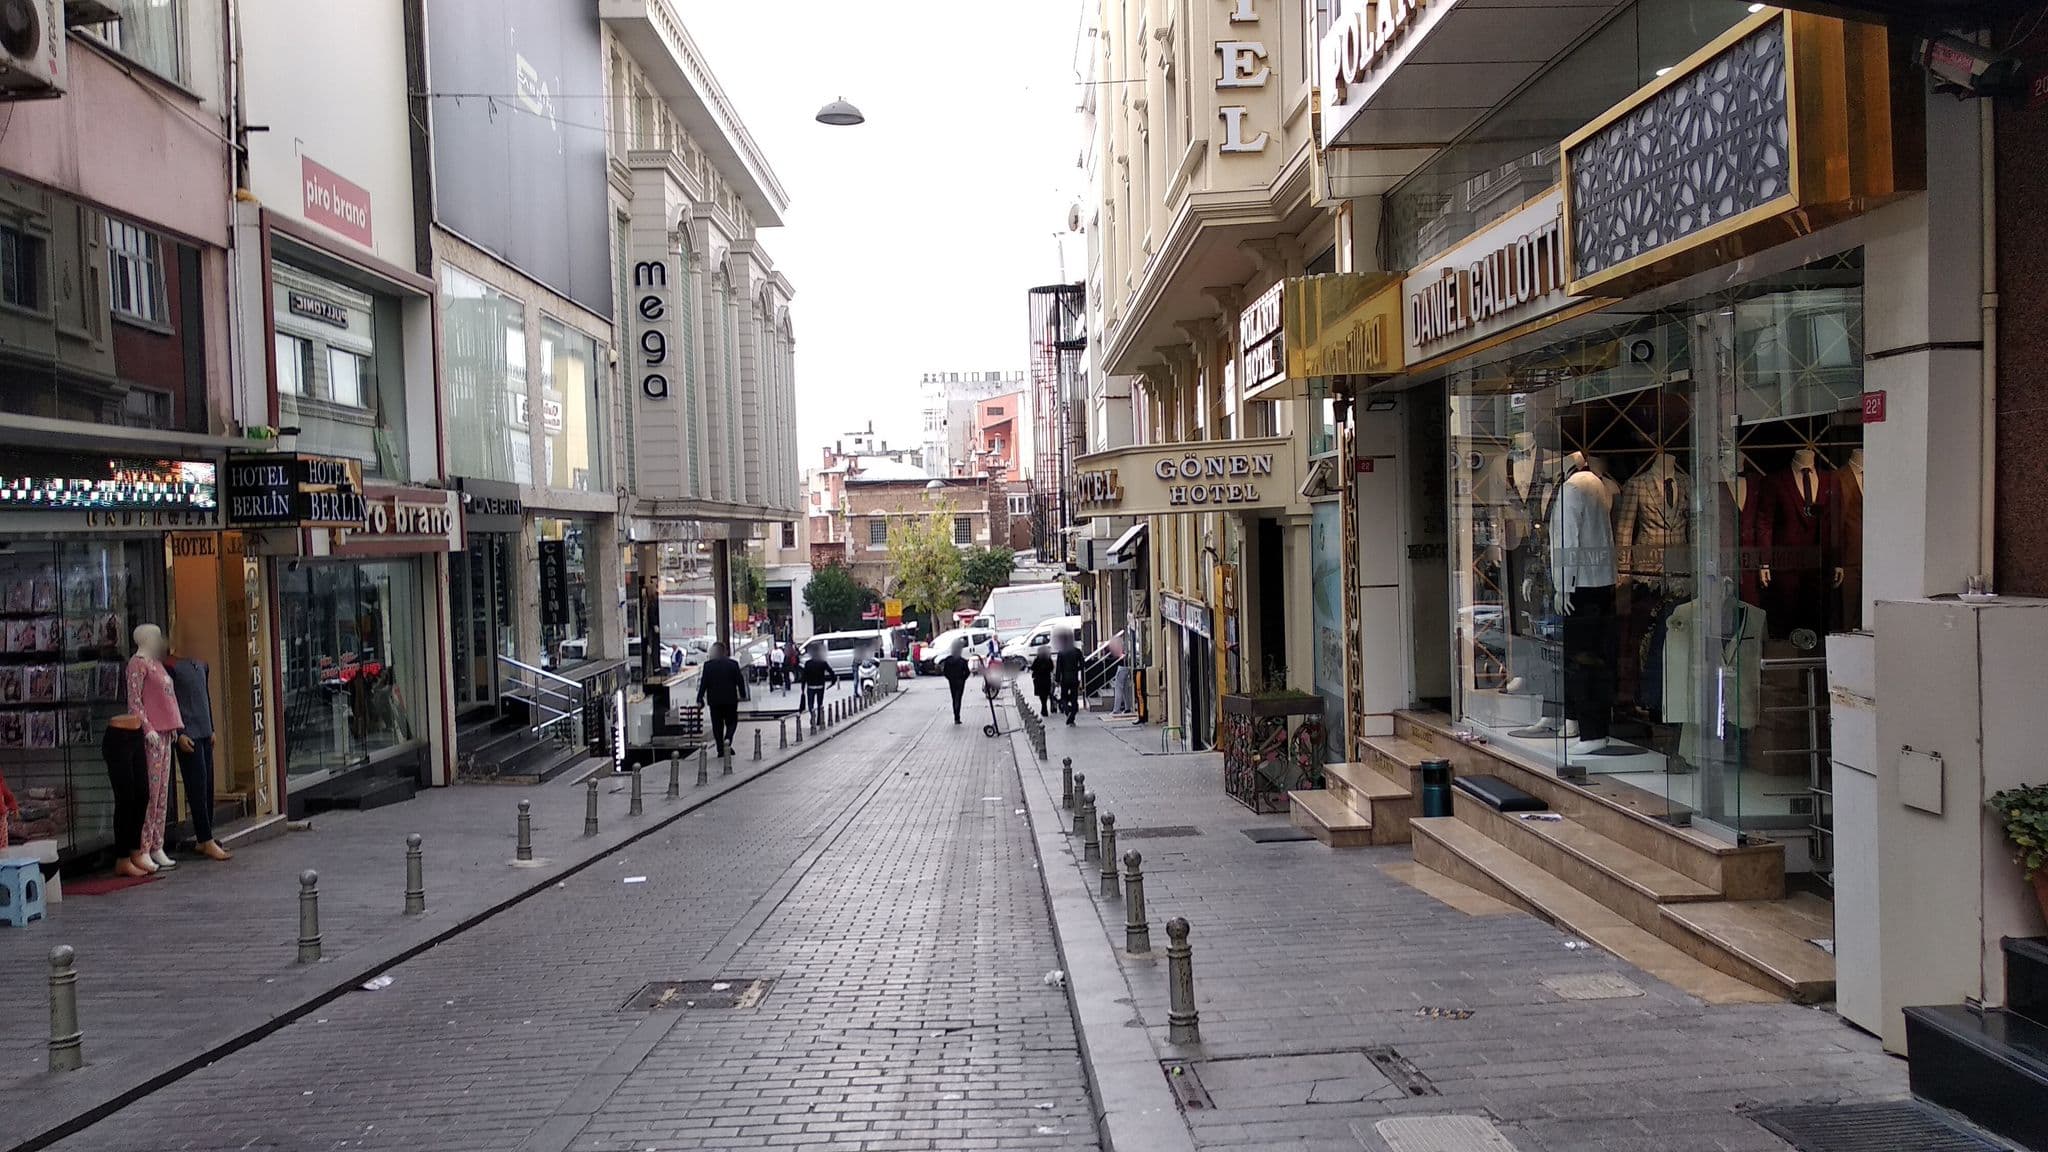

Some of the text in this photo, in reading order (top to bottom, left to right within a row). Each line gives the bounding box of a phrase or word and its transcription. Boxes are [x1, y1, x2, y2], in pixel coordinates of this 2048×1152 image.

[306, 176, 366, 229] piro brano
[635, 261, 668, 398] mega
[1246, 340, 1276, 387] HOTEL
[231, 466, 289, 487] HOTEL
[309, 459, 350, 485] HOTEL
[1155, 453, 1274, 480] GÖNEN
[233, 490, 289, 517] BERLİN
[311, 487, 368, 521] BERLİN
[1170, 484, 1260, 505] HOTEL
[395, 496, 453, 535] brano
[172, 536, 215, 556] HOTEL
[246, 545, 261, 656] HOTEL
